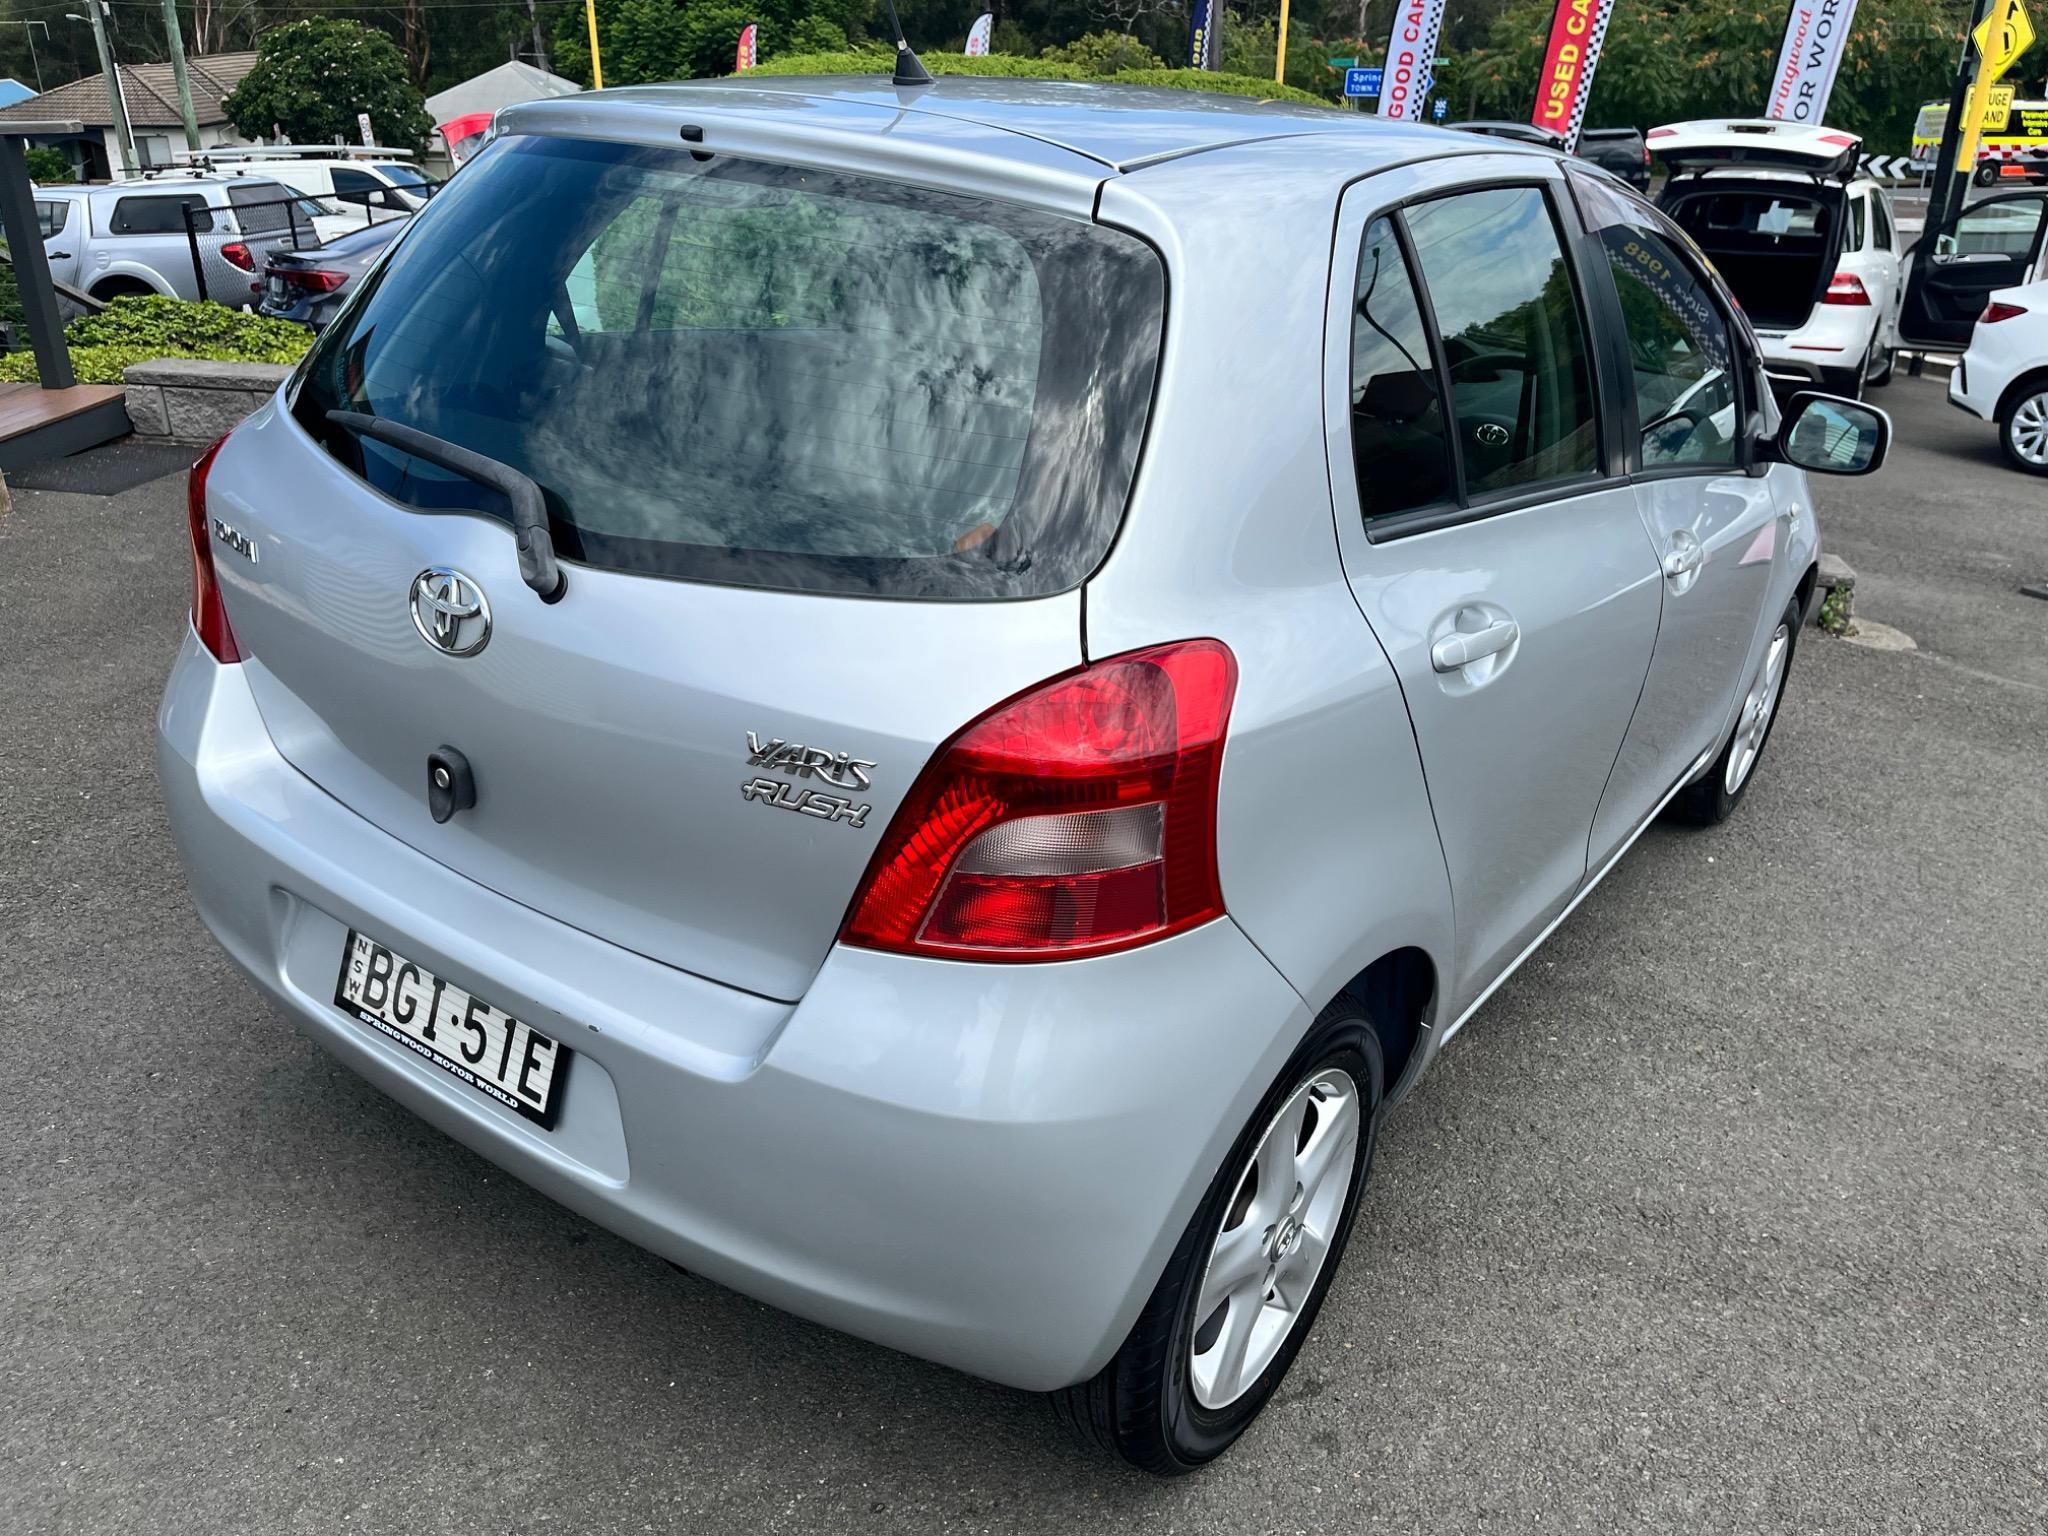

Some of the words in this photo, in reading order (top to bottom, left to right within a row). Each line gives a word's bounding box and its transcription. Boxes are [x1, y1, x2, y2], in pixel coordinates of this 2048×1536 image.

[1388, 51, 1415, 119] GOOD
[1544, 43, 1579, 119] USED
[1794, 81, 1817, 120] OR
[1982, 111, 2004, 123] AND
[742, 777, 872, 828] RUSH
[359, 1010, 433, 1059] SPRINGWOOD
[432, 1055, 475, 1084] MOTOR
[476, 1078, 519, 1109] WORLD
